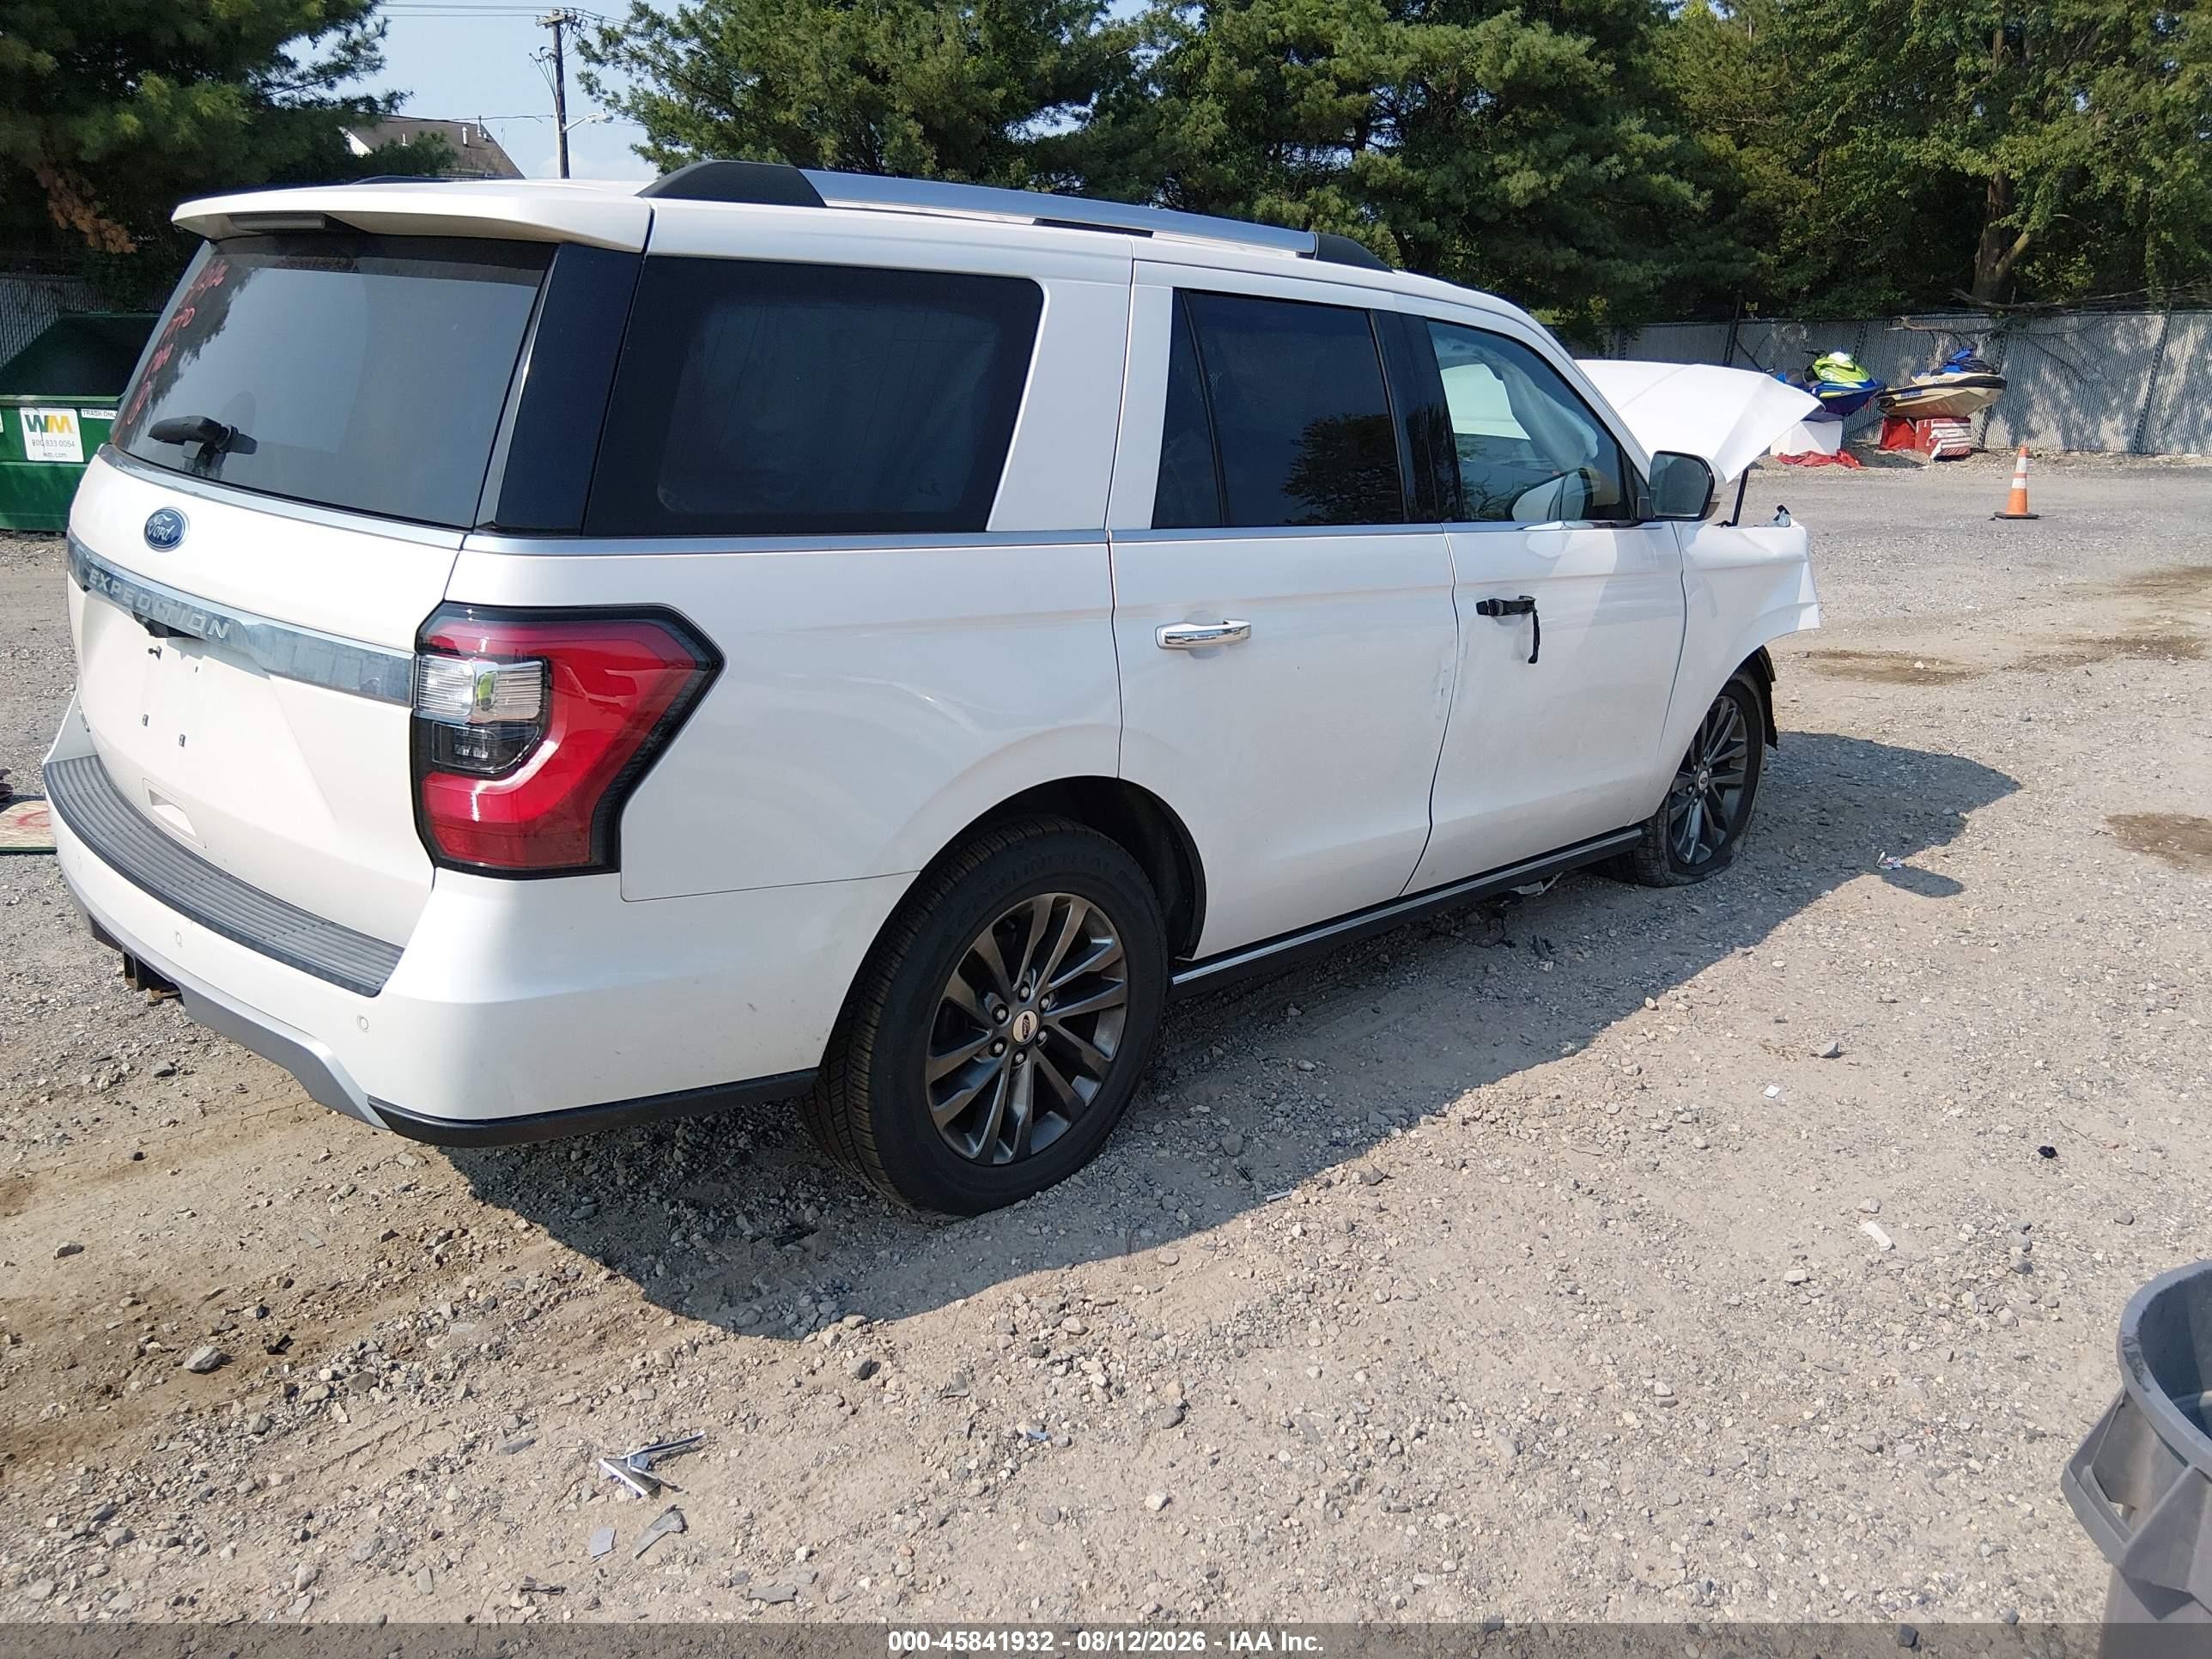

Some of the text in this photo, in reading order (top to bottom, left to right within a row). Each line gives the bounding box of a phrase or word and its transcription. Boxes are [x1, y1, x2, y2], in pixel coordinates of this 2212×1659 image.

[24, 414, 76, 434] WM
[146, 513, 175, 543] Ford
[88, 569, 231, 640] EXPEDITION
